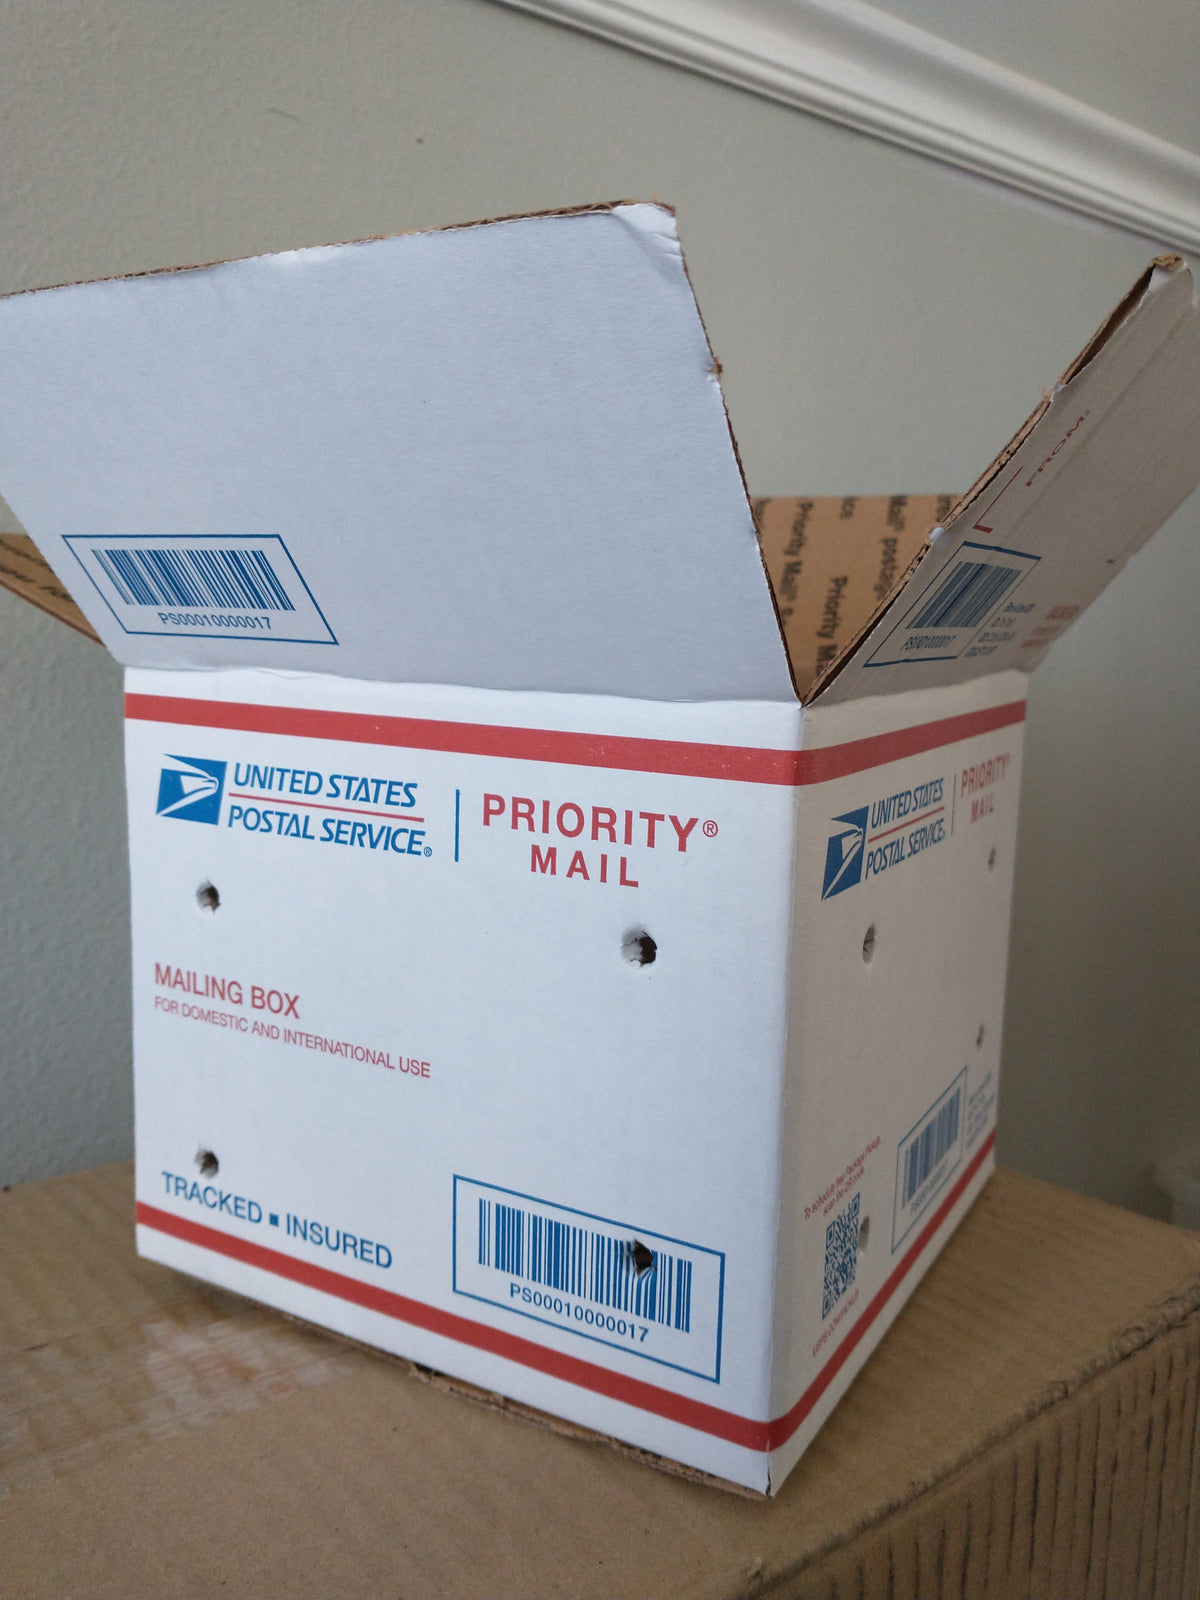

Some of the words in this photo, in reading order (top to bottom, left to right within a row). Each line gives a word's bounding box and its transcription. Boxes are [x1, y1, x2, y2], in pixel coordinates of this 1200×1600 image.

[158, 611, 273, 631] PS00010000017
[816, 576, 848, 640] Priority
[234, 761, 323, 796] UNITED
[326, 773, 418, 808] STATES
[871, 789, 911, 829] UNITED
[911, 777, 944, 813] STATES
[970, 791, 994, 824] MAIL
[228, 804, 315, 840] POSTAL
[530, 844, 639, 888] MAIL
[865, 836, 905, 880] POSTAL
[154, 962, 243, 1005] MAILING
[250, 985, 301, 1019] BOX
[154, 995, 180, 1016] FOR
[181, 1003, 249, 1033] DOMESTIC
[251, 1020, 281, 1040] AND
[283, 1027, 396, 1071] INTERNATIONAL
[399, 1055, 431, 1079] USE
[161, 1170, 262, 1225] TRACKED
[286, 1213, 393, 1270] INSURED
[510, 1282, 649, 1343] PS00010000017
